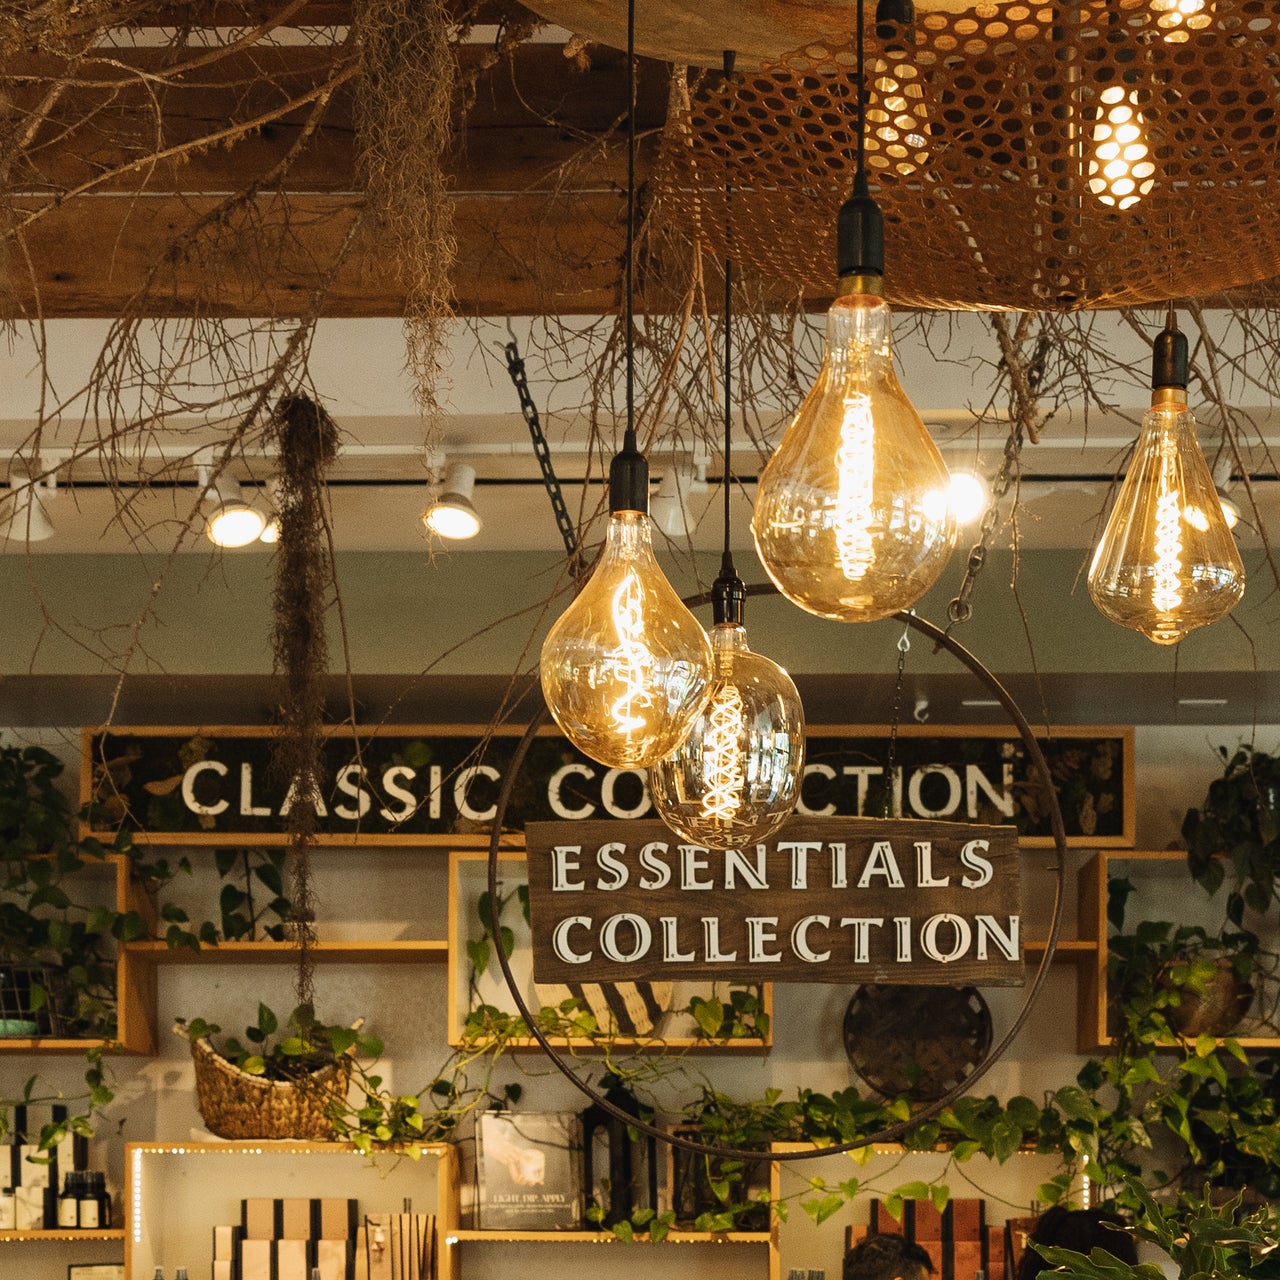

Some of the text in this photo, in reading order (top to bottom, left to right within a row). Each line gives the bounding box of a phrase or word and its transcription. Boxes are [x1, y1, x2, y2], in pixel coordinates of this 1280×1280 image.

[181, 760, 1015, 821] CLASSIC COCTION
[552, 839, 993, 891] ESSENTIALS
[551, 913, 1021, 963] COLLECTION
